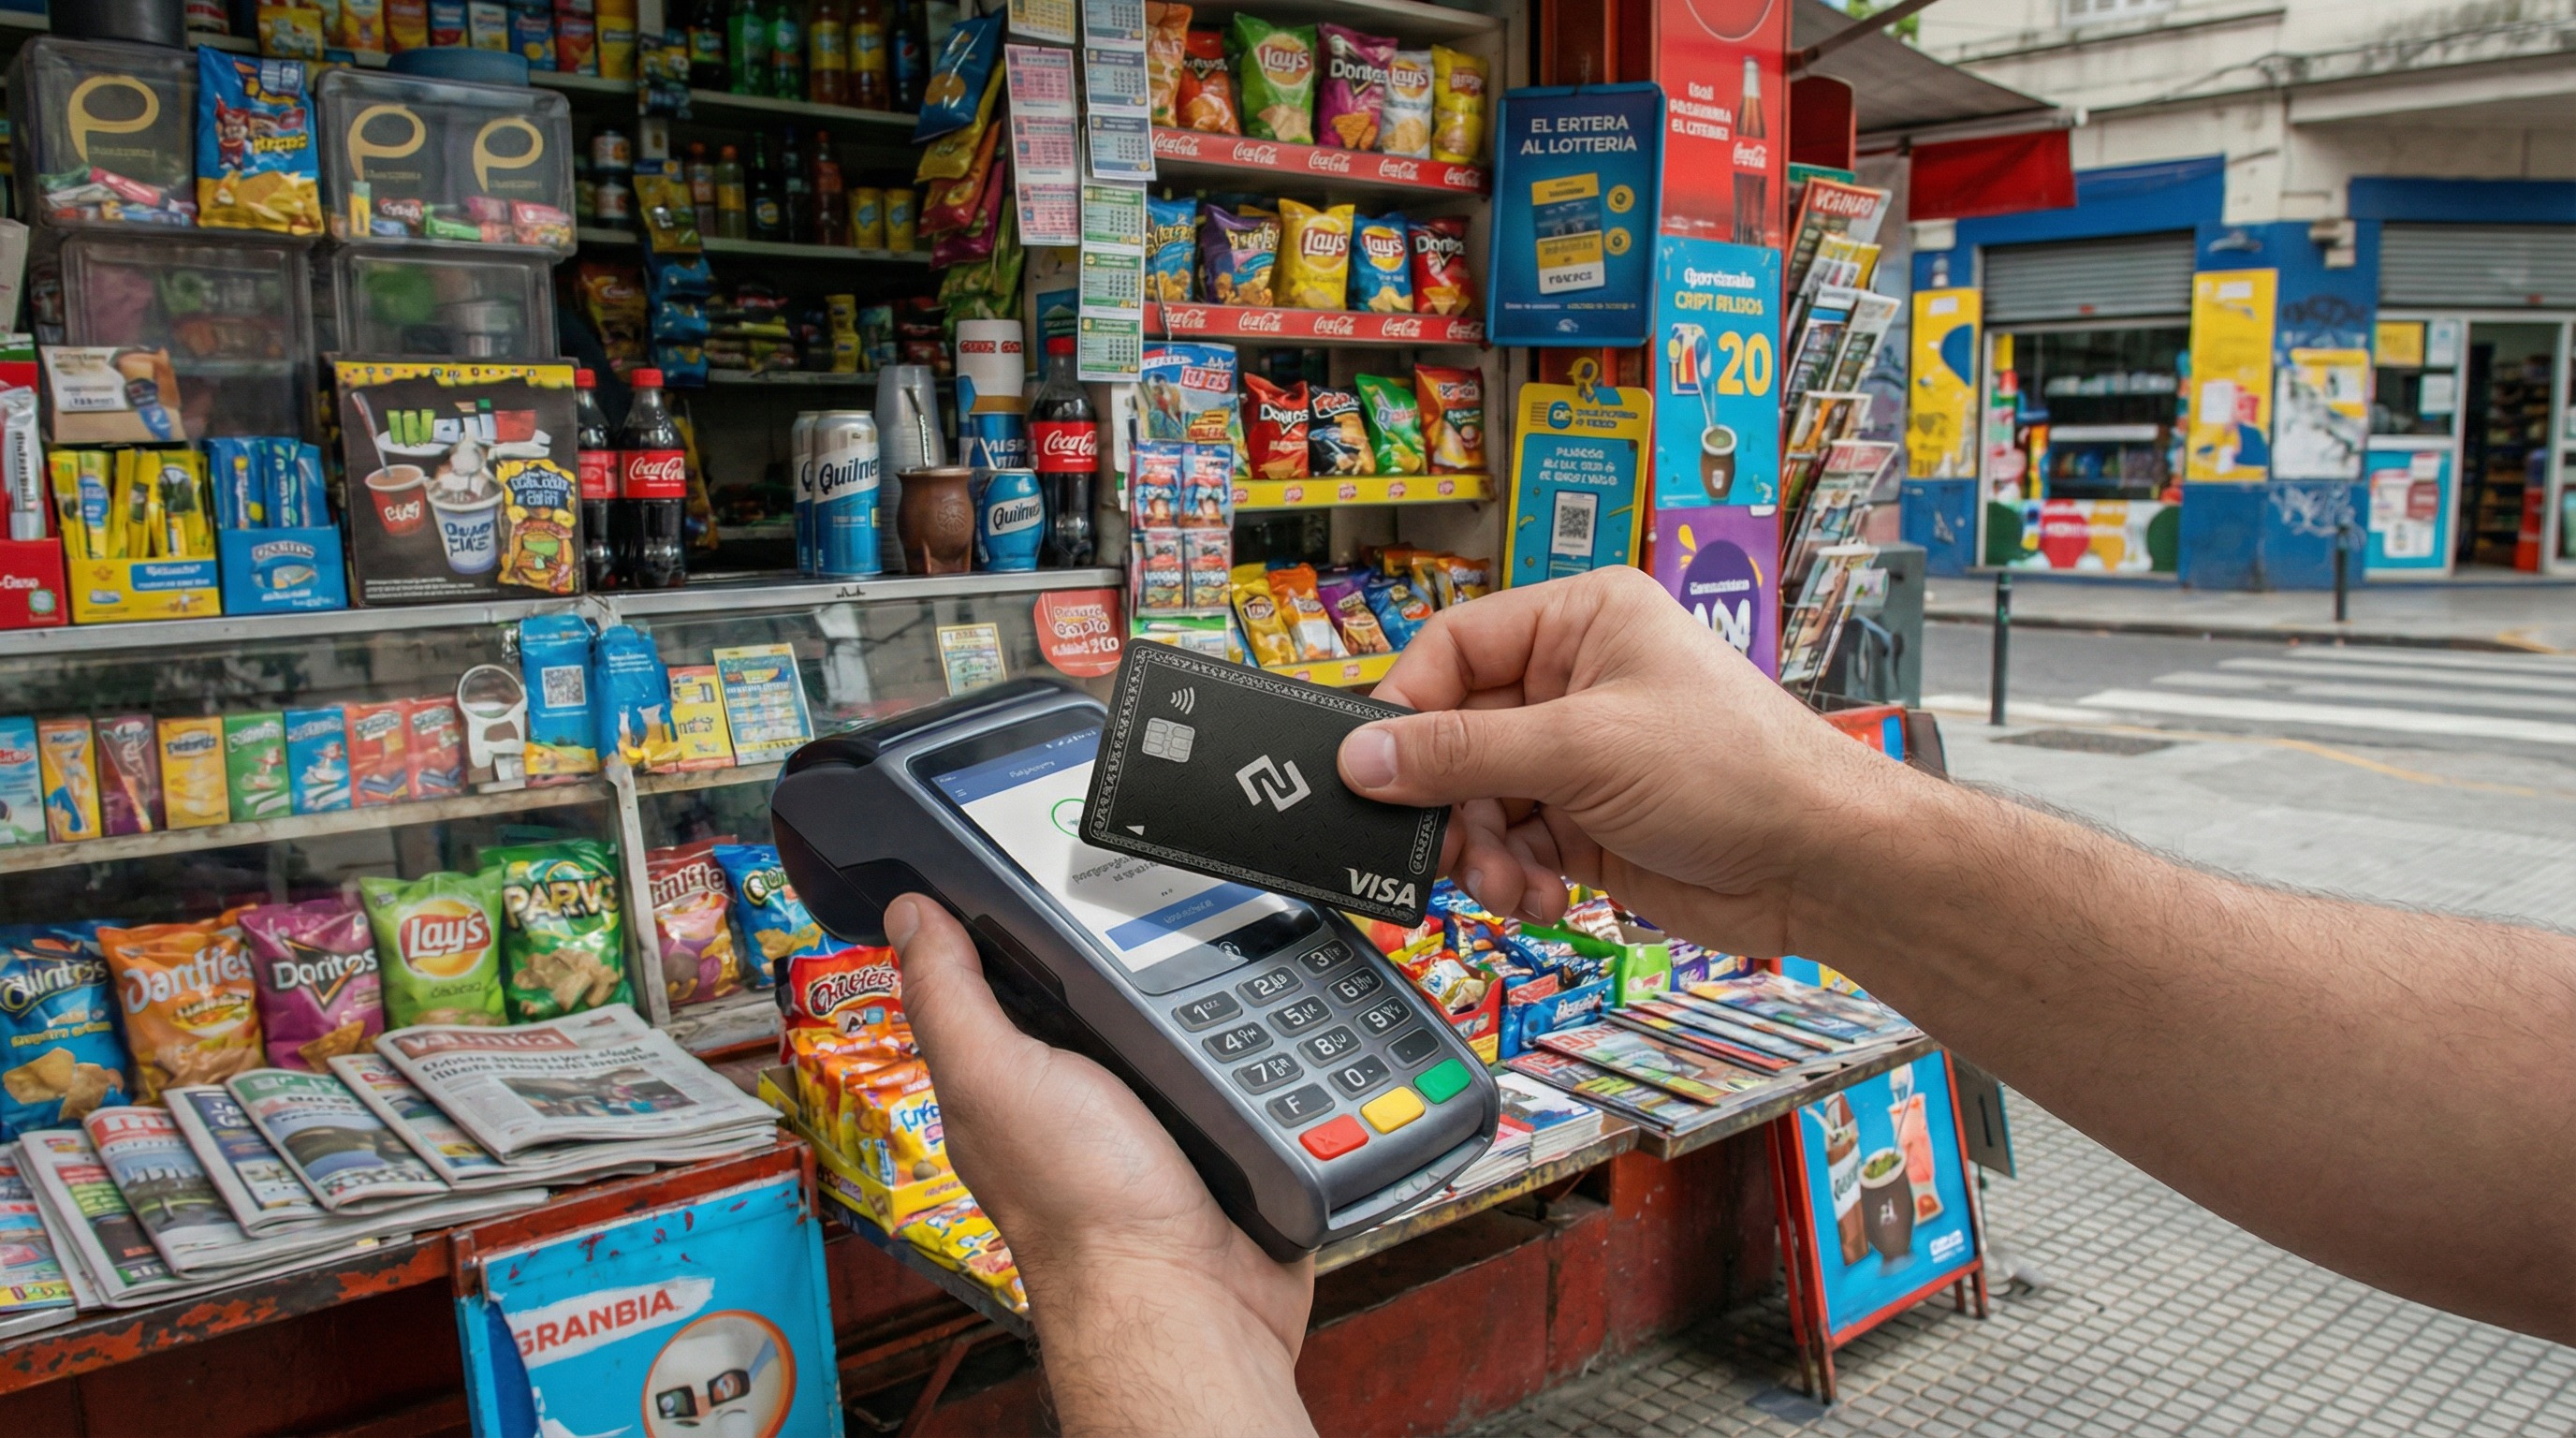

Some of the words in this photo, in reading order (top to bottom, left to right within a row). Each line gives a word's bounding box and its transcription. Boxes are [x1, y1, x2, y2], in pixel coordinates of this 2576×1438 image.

[1531, 118, 1553, 134] EL
[1557, 114, 1630, 133] ERTERA
[1520, 139, 1545, 155] AL
[1717, 330, 1773, 397] 20
[1342, 867, 1416, 909] VISA
[409, 912, 484, 959] Lay's
[272, 947, 378, 990] Doritos
[1310, 951, 1330, 967] 3
[1253, 979, 1275, 996] 2
[1339, 981, 1359, 998] 6
[1193, 1005, 1210, 1020] 1
[1283, 1007, 1305, 1026] 5
[1368, 1011, 1388, 1028] 9
[1225, 1033, 1243, 1050] 4
[1314, 1037, 1336, 1056] 8
[1251, 1063, 1268, 1083] 7
[1343, 1067, 1367, 1087] 0
[1284, 1094, 1301, 1115] F
[515, 1288, 676, 1357] GRANBIA
